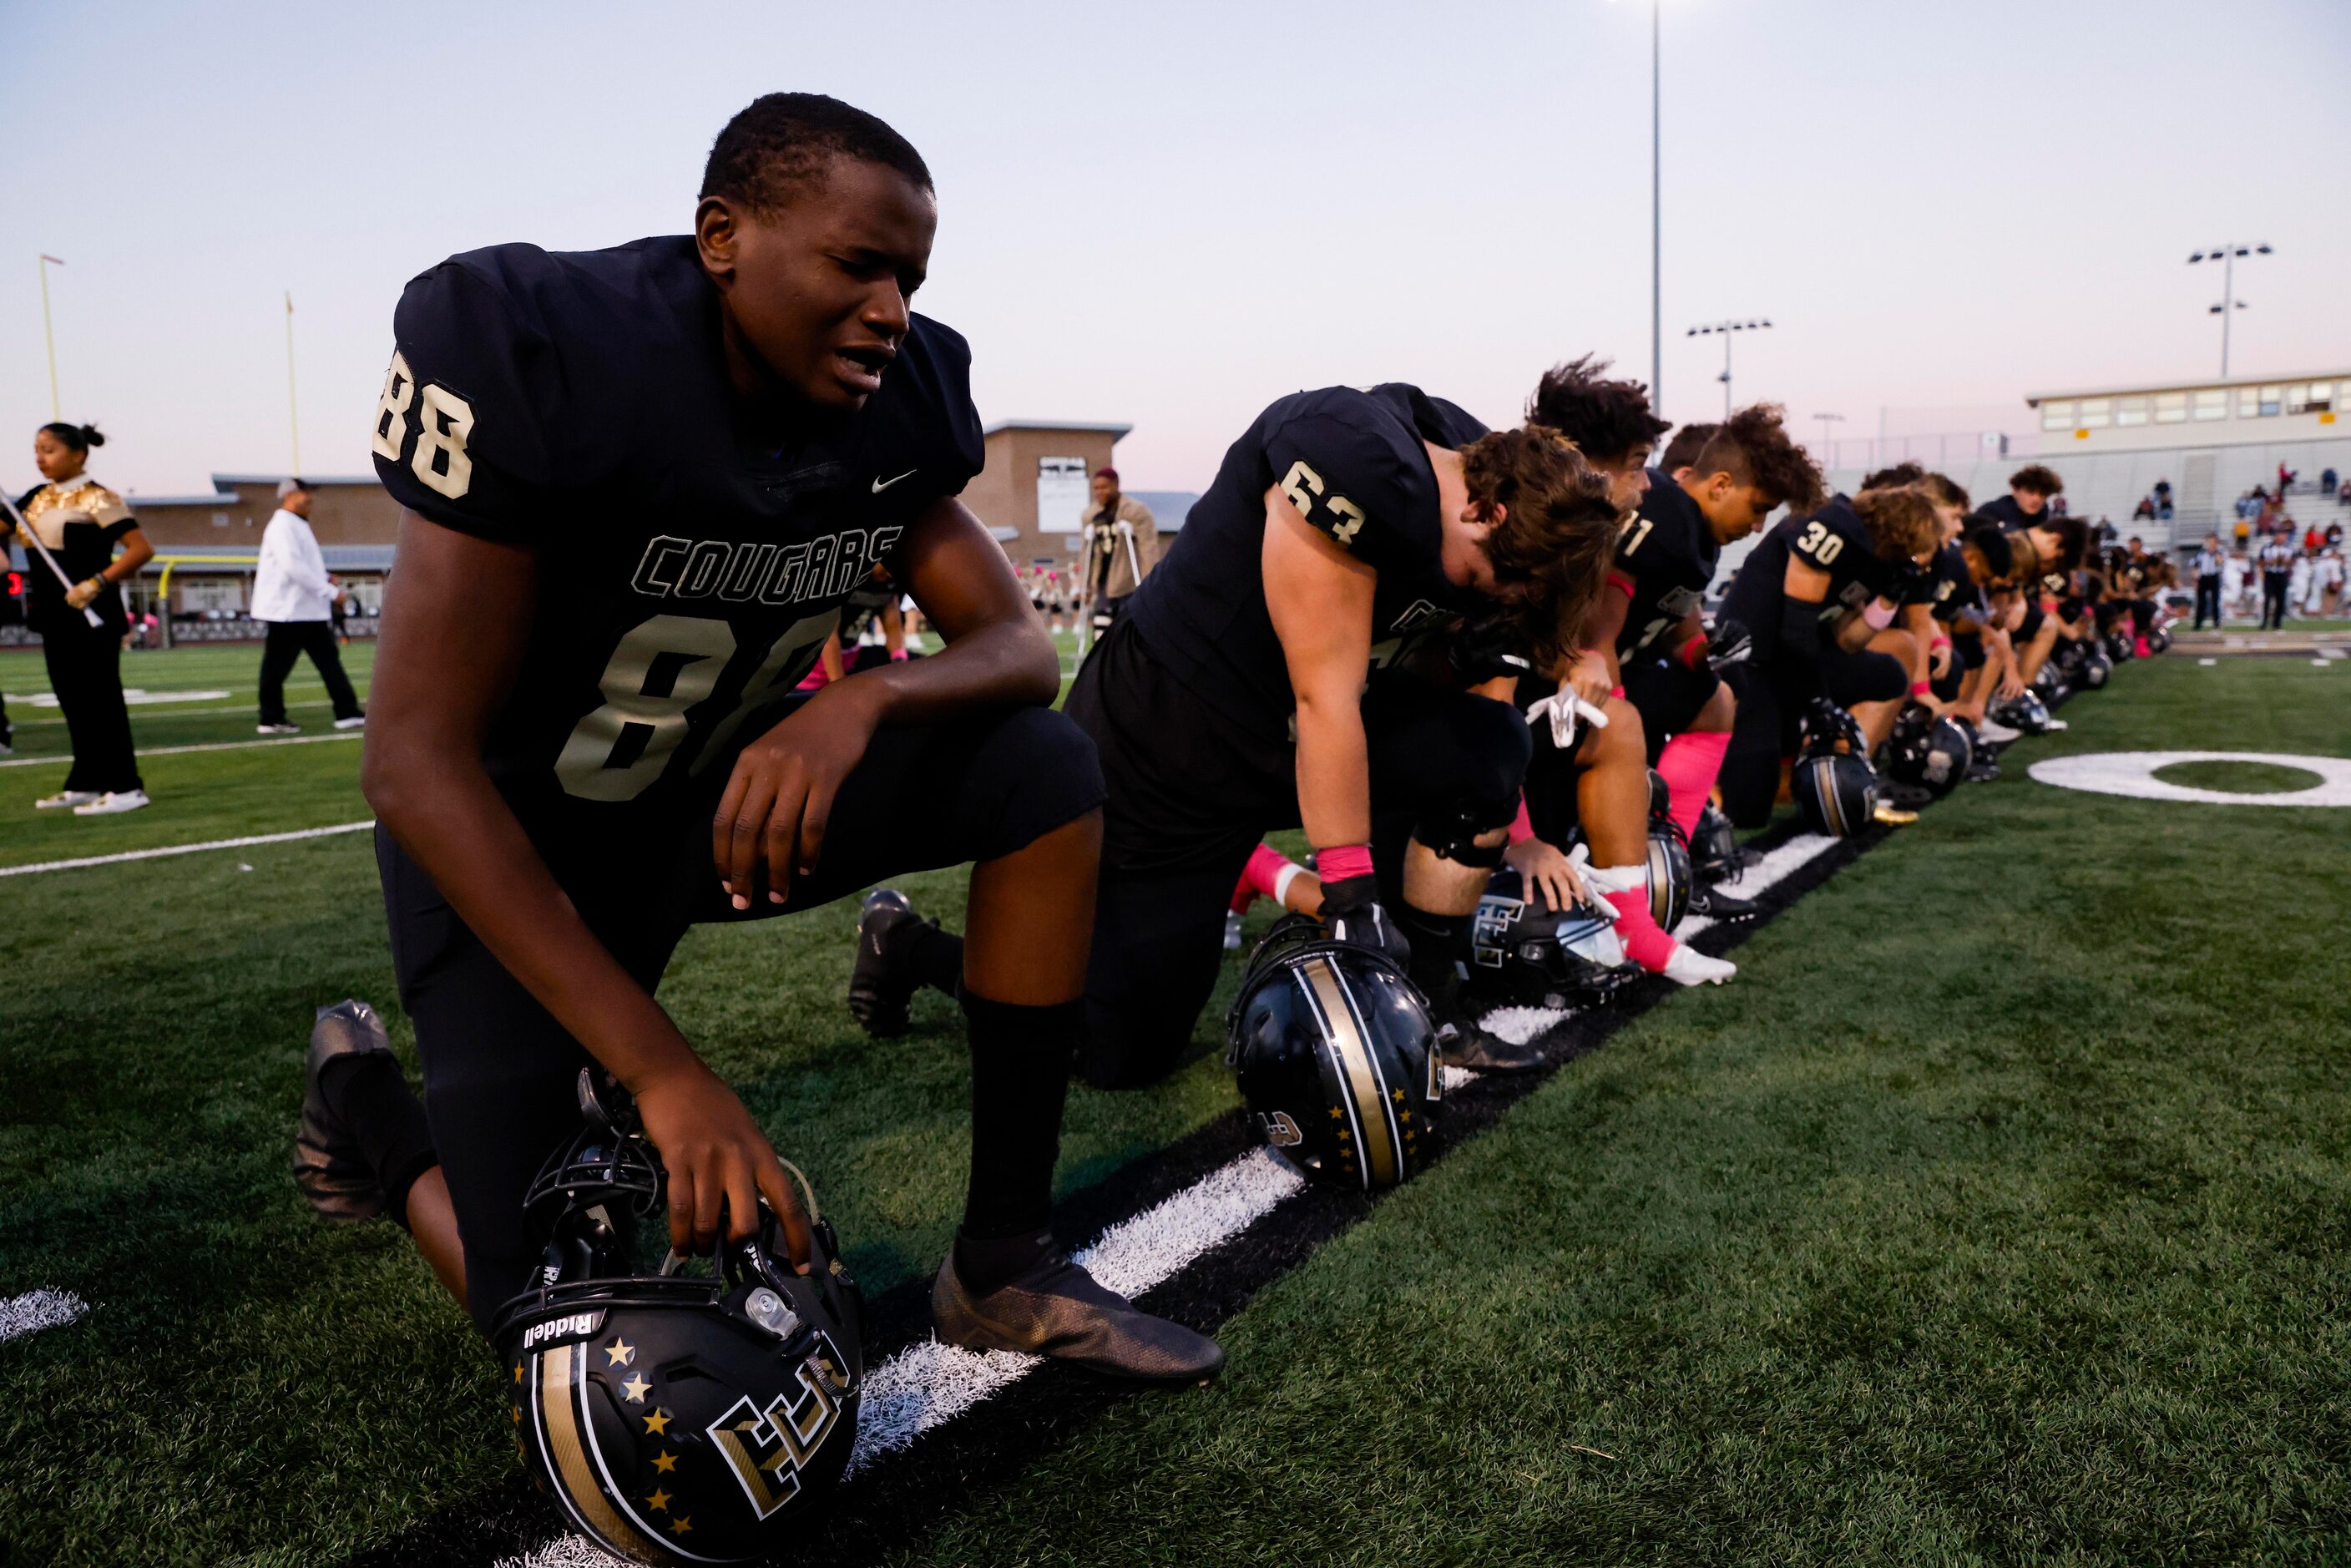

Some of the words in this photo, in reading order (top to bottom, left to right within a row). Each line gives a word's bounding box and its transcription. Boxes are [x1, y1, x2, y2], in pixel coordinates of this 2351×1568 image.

[372, 349, 475, 499] 88
[1279, 460, 1367, 548] 63
[1797, 521, 1843, 565] 30
[630, 525, 904, 605] COUGARS
[523, 1314, 593, 1348] Riddell
